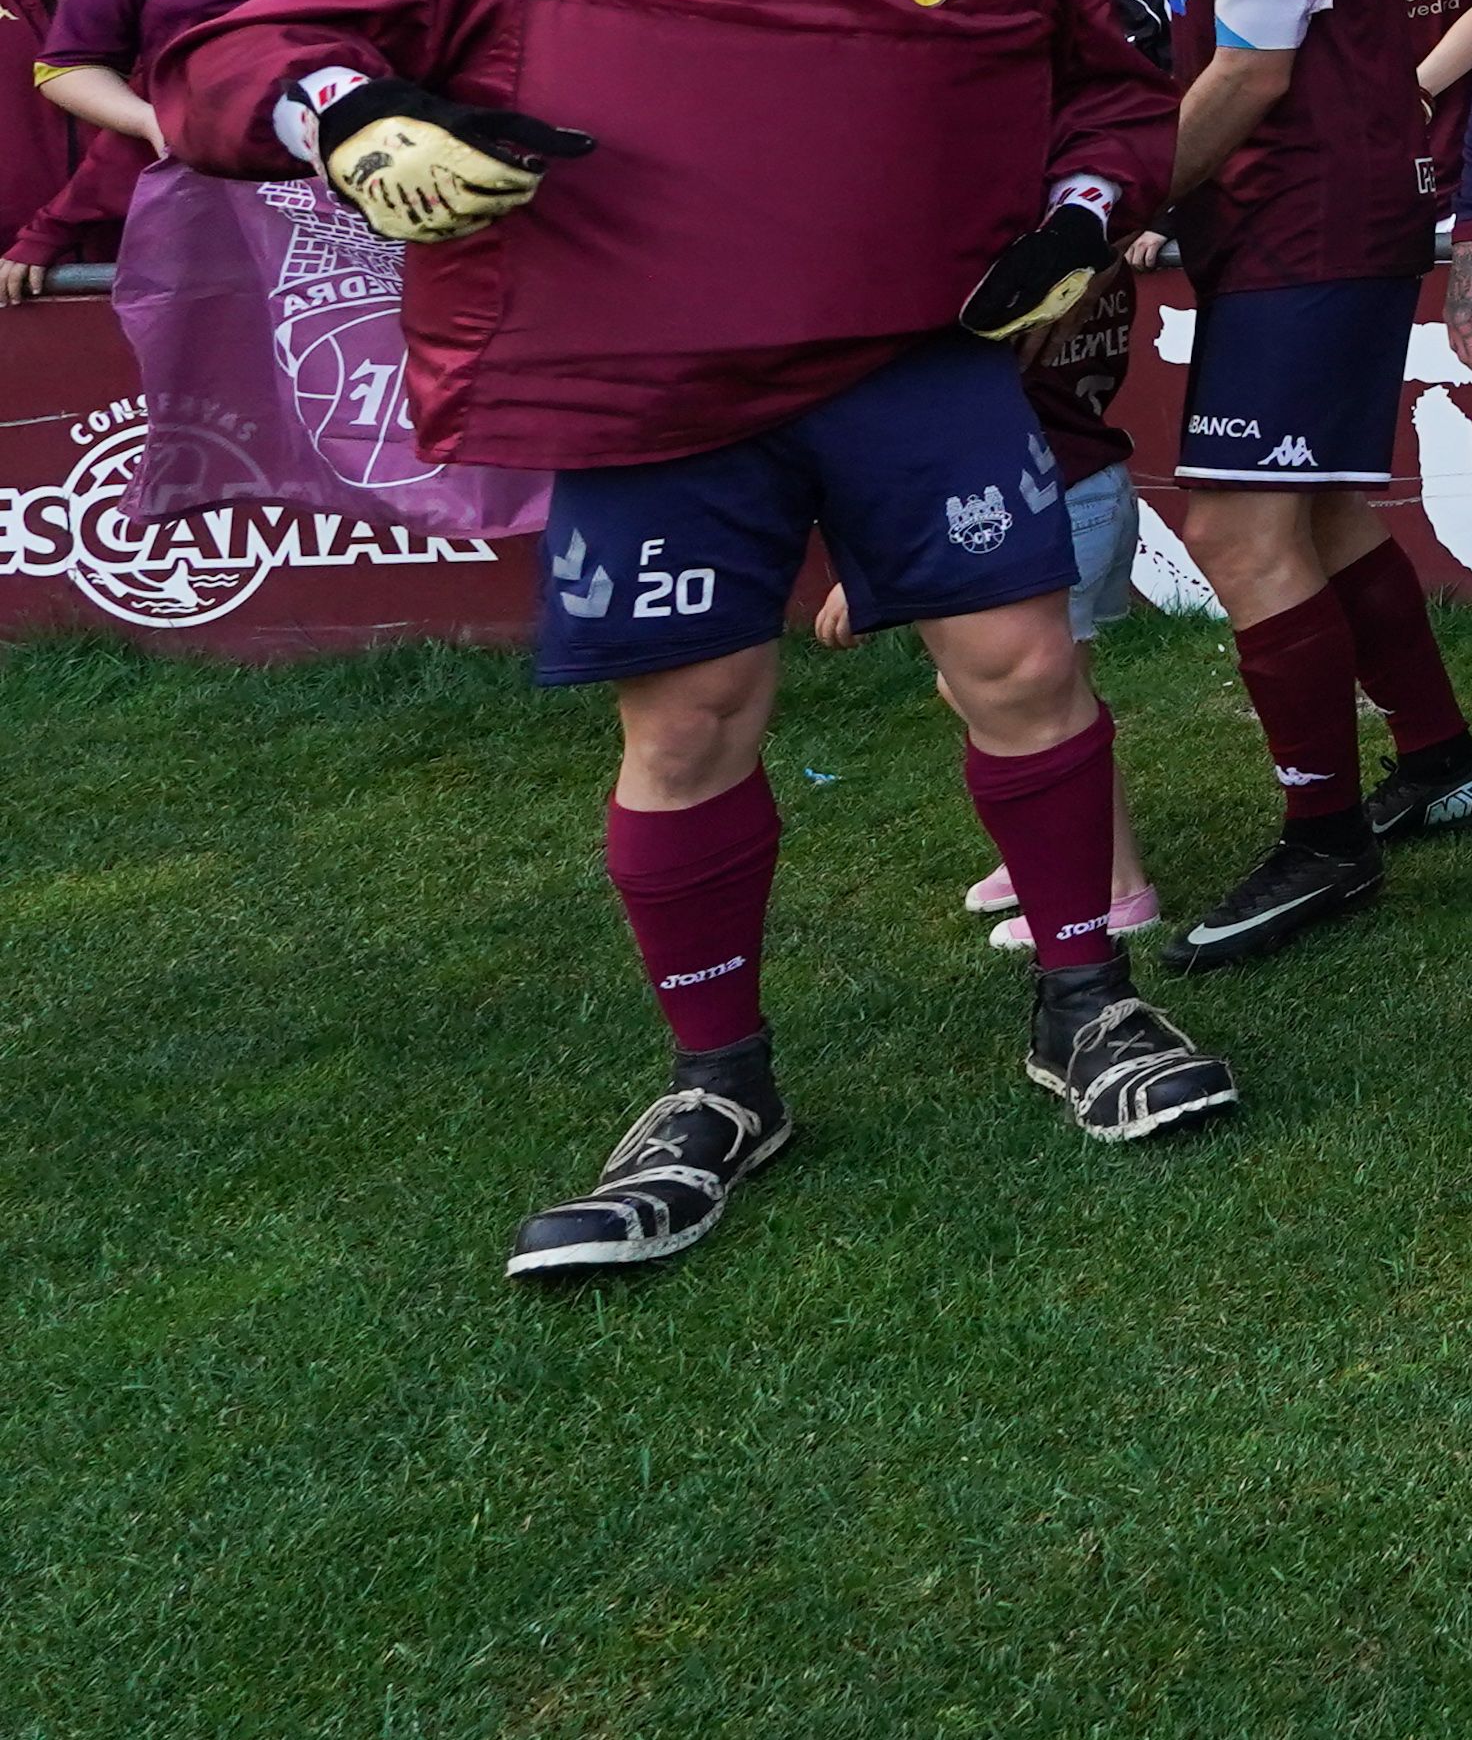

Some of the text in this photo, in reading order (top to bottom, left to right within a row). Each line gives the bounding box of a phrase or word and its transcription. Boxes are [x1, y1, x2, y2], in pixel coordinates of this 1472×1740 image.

[640, 538, 664, 567] F
[633, 567, 716, 619] 20
[660, 955, 746, 990] Joma
